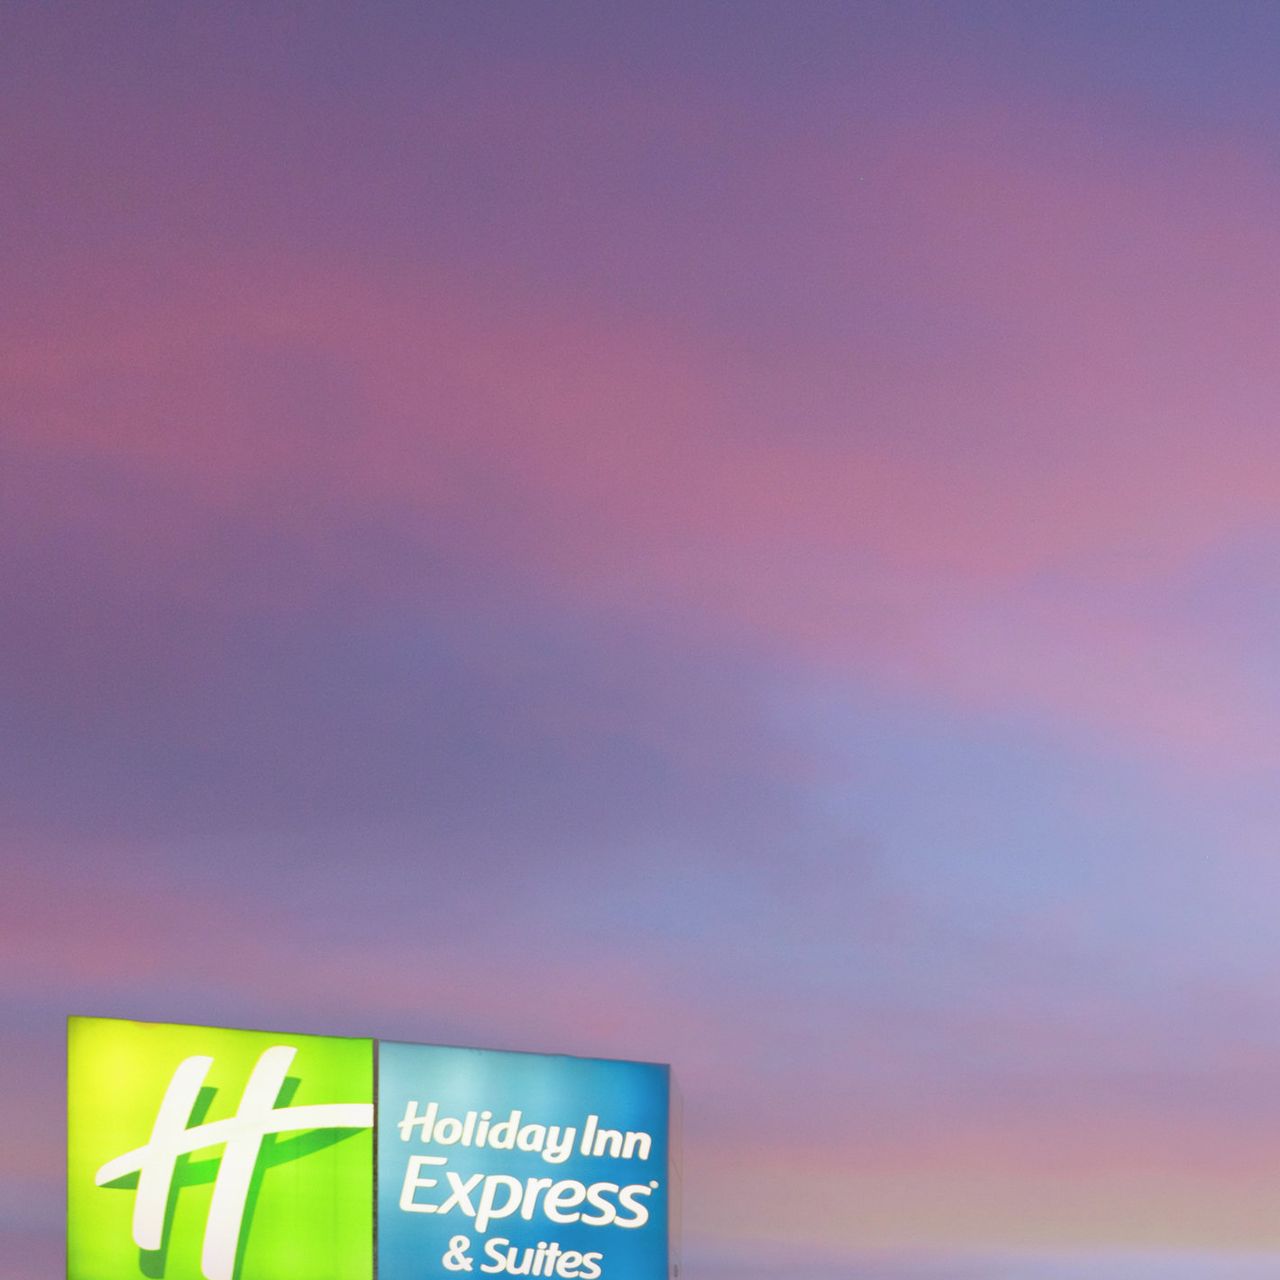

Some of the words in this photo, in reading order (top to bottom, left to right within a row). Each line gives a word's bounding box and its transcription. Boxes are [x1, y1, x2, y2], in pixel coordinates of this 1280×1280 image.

[397, 1100, 576, 1164] Holiday
[581, 1115, 652, 1160] Inn
[399, 1155, 653, 1233] Express
[442, 1235, 474, 1272] &
[480, 1237, 604, 1280] Suites
